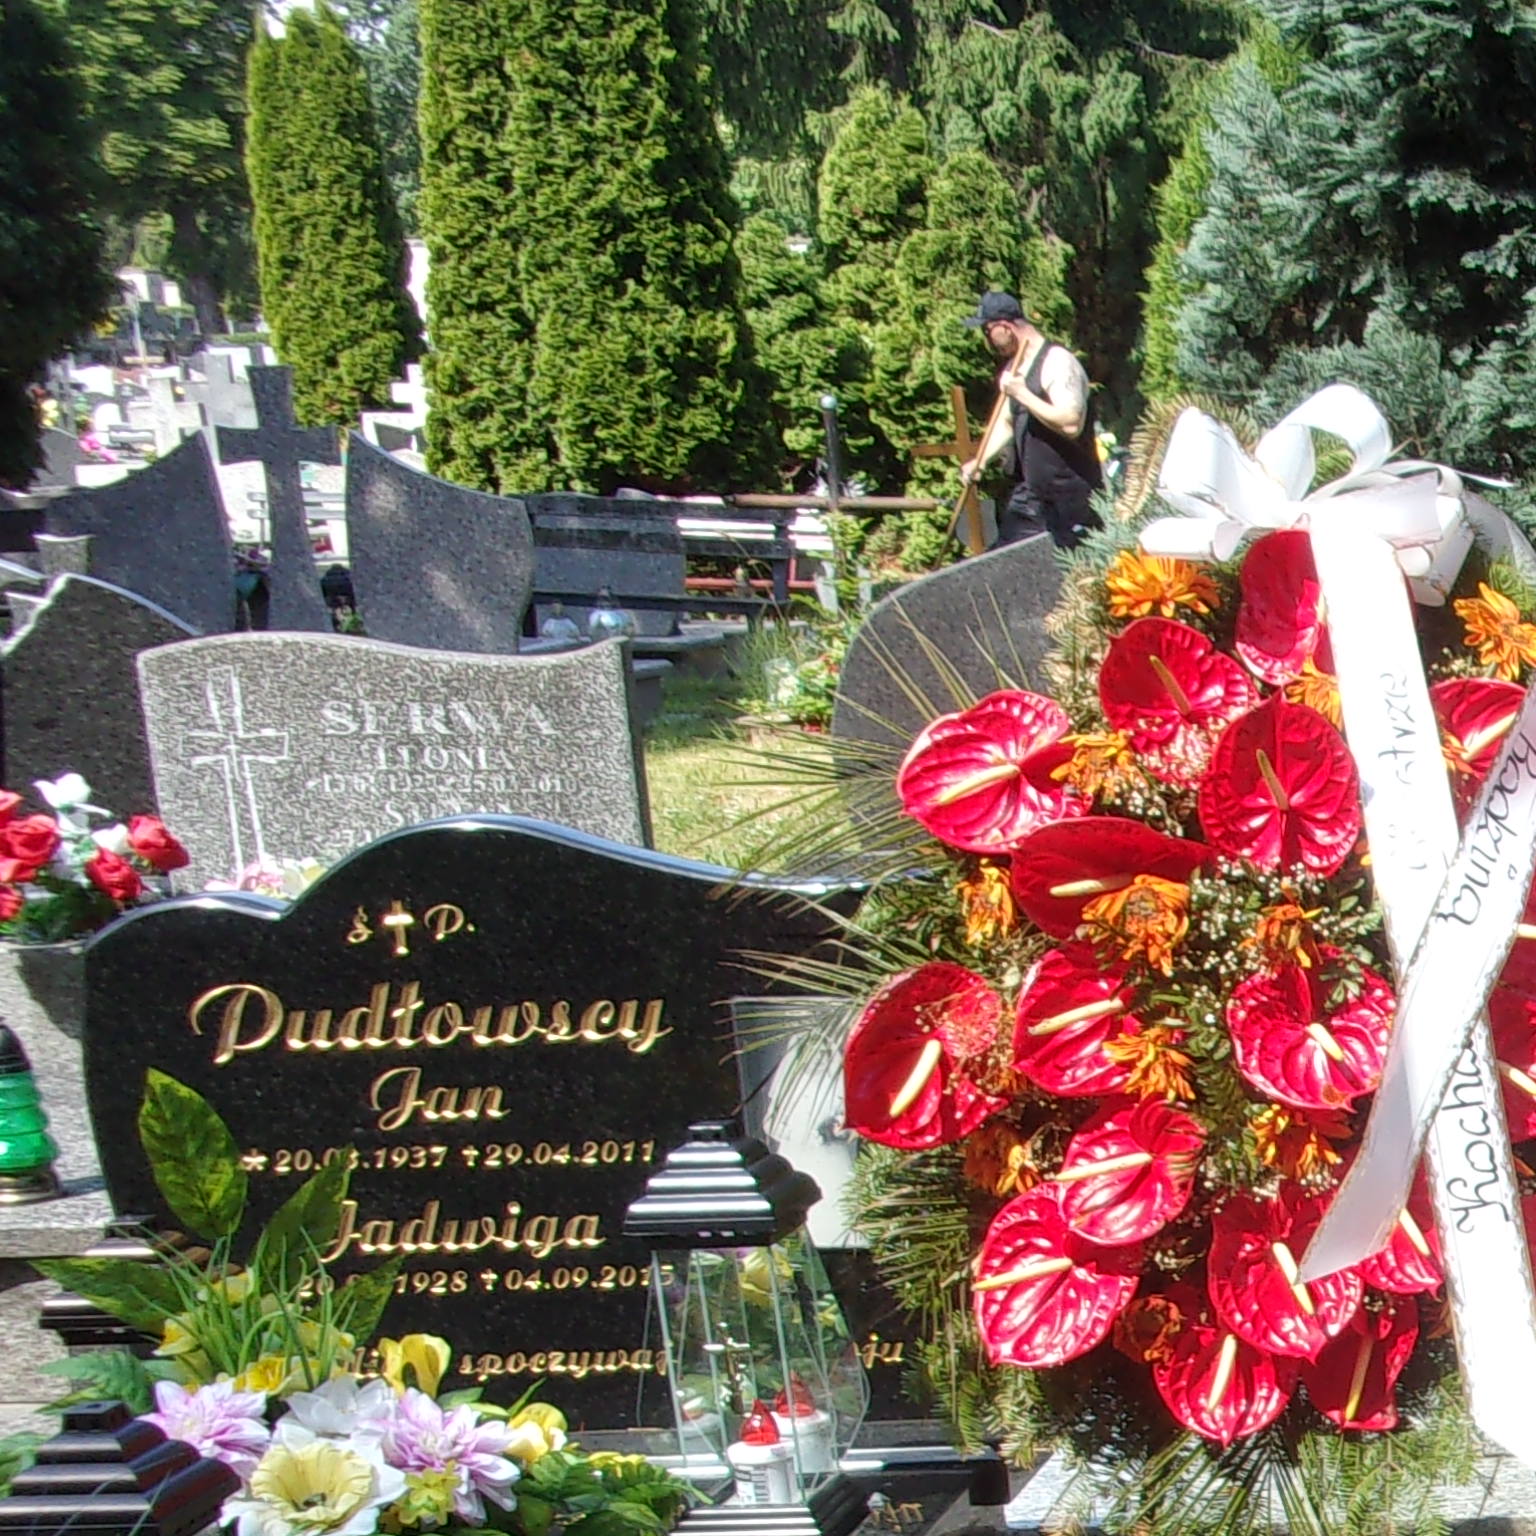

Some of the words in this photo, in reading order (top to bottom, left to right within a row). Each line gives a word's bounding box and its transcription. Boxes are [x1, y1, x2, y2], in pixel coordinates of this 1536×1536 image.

[321, 699, 558, 736] SERWA
[190, 979, 675, 1065] Pudłowscy
[370, 1066, 512, 1132] Jan
[483, 1139, 657, 1169] 29.04.2011
[1440, 1040, 1511, 1234] Kocha
[318, 1200, 607, 1263] Jadwiga
